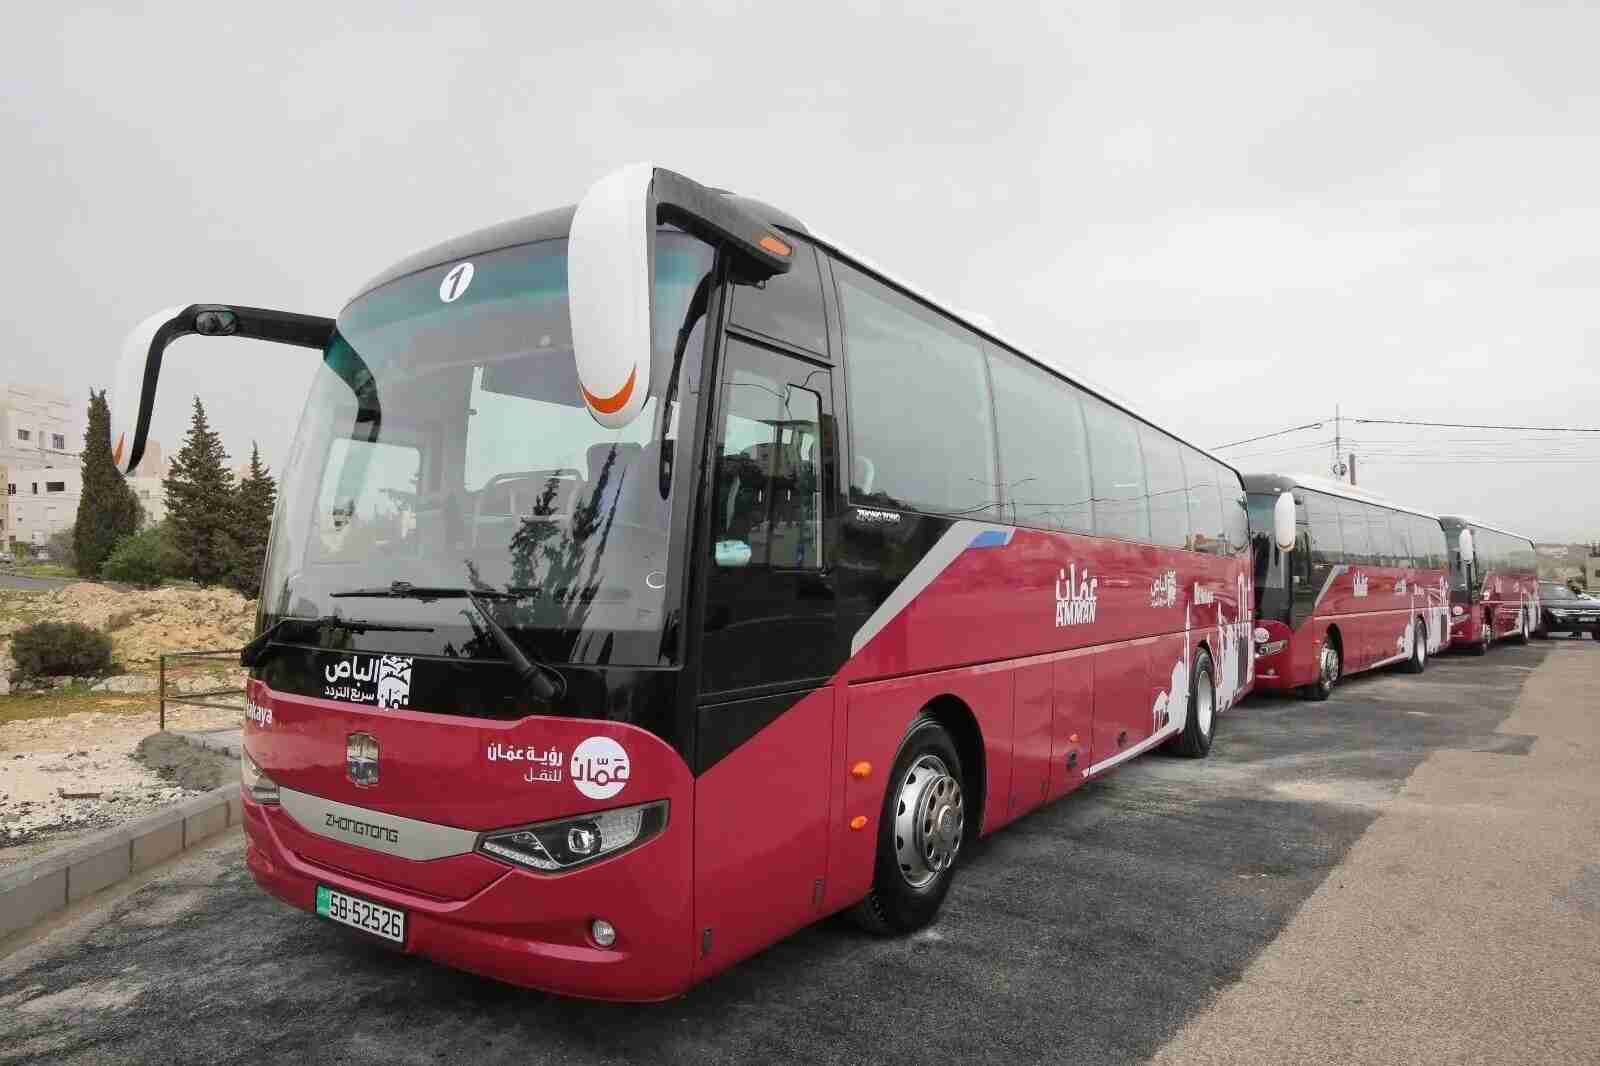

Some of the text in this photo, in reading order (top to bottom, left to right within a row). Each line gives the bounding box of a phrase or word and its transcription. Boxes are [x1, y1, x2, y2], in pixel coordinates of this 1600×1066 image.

[449, 266, 465, 299] 1
[1055, 600, 1097, 628] AMMAN
[324, 655, 380, 688] الباص
[526, 745, 563, 767] رؤية
[523, 767, 562, 784] للنقل
[325, 812, 399, 843] ZHONGTONG
